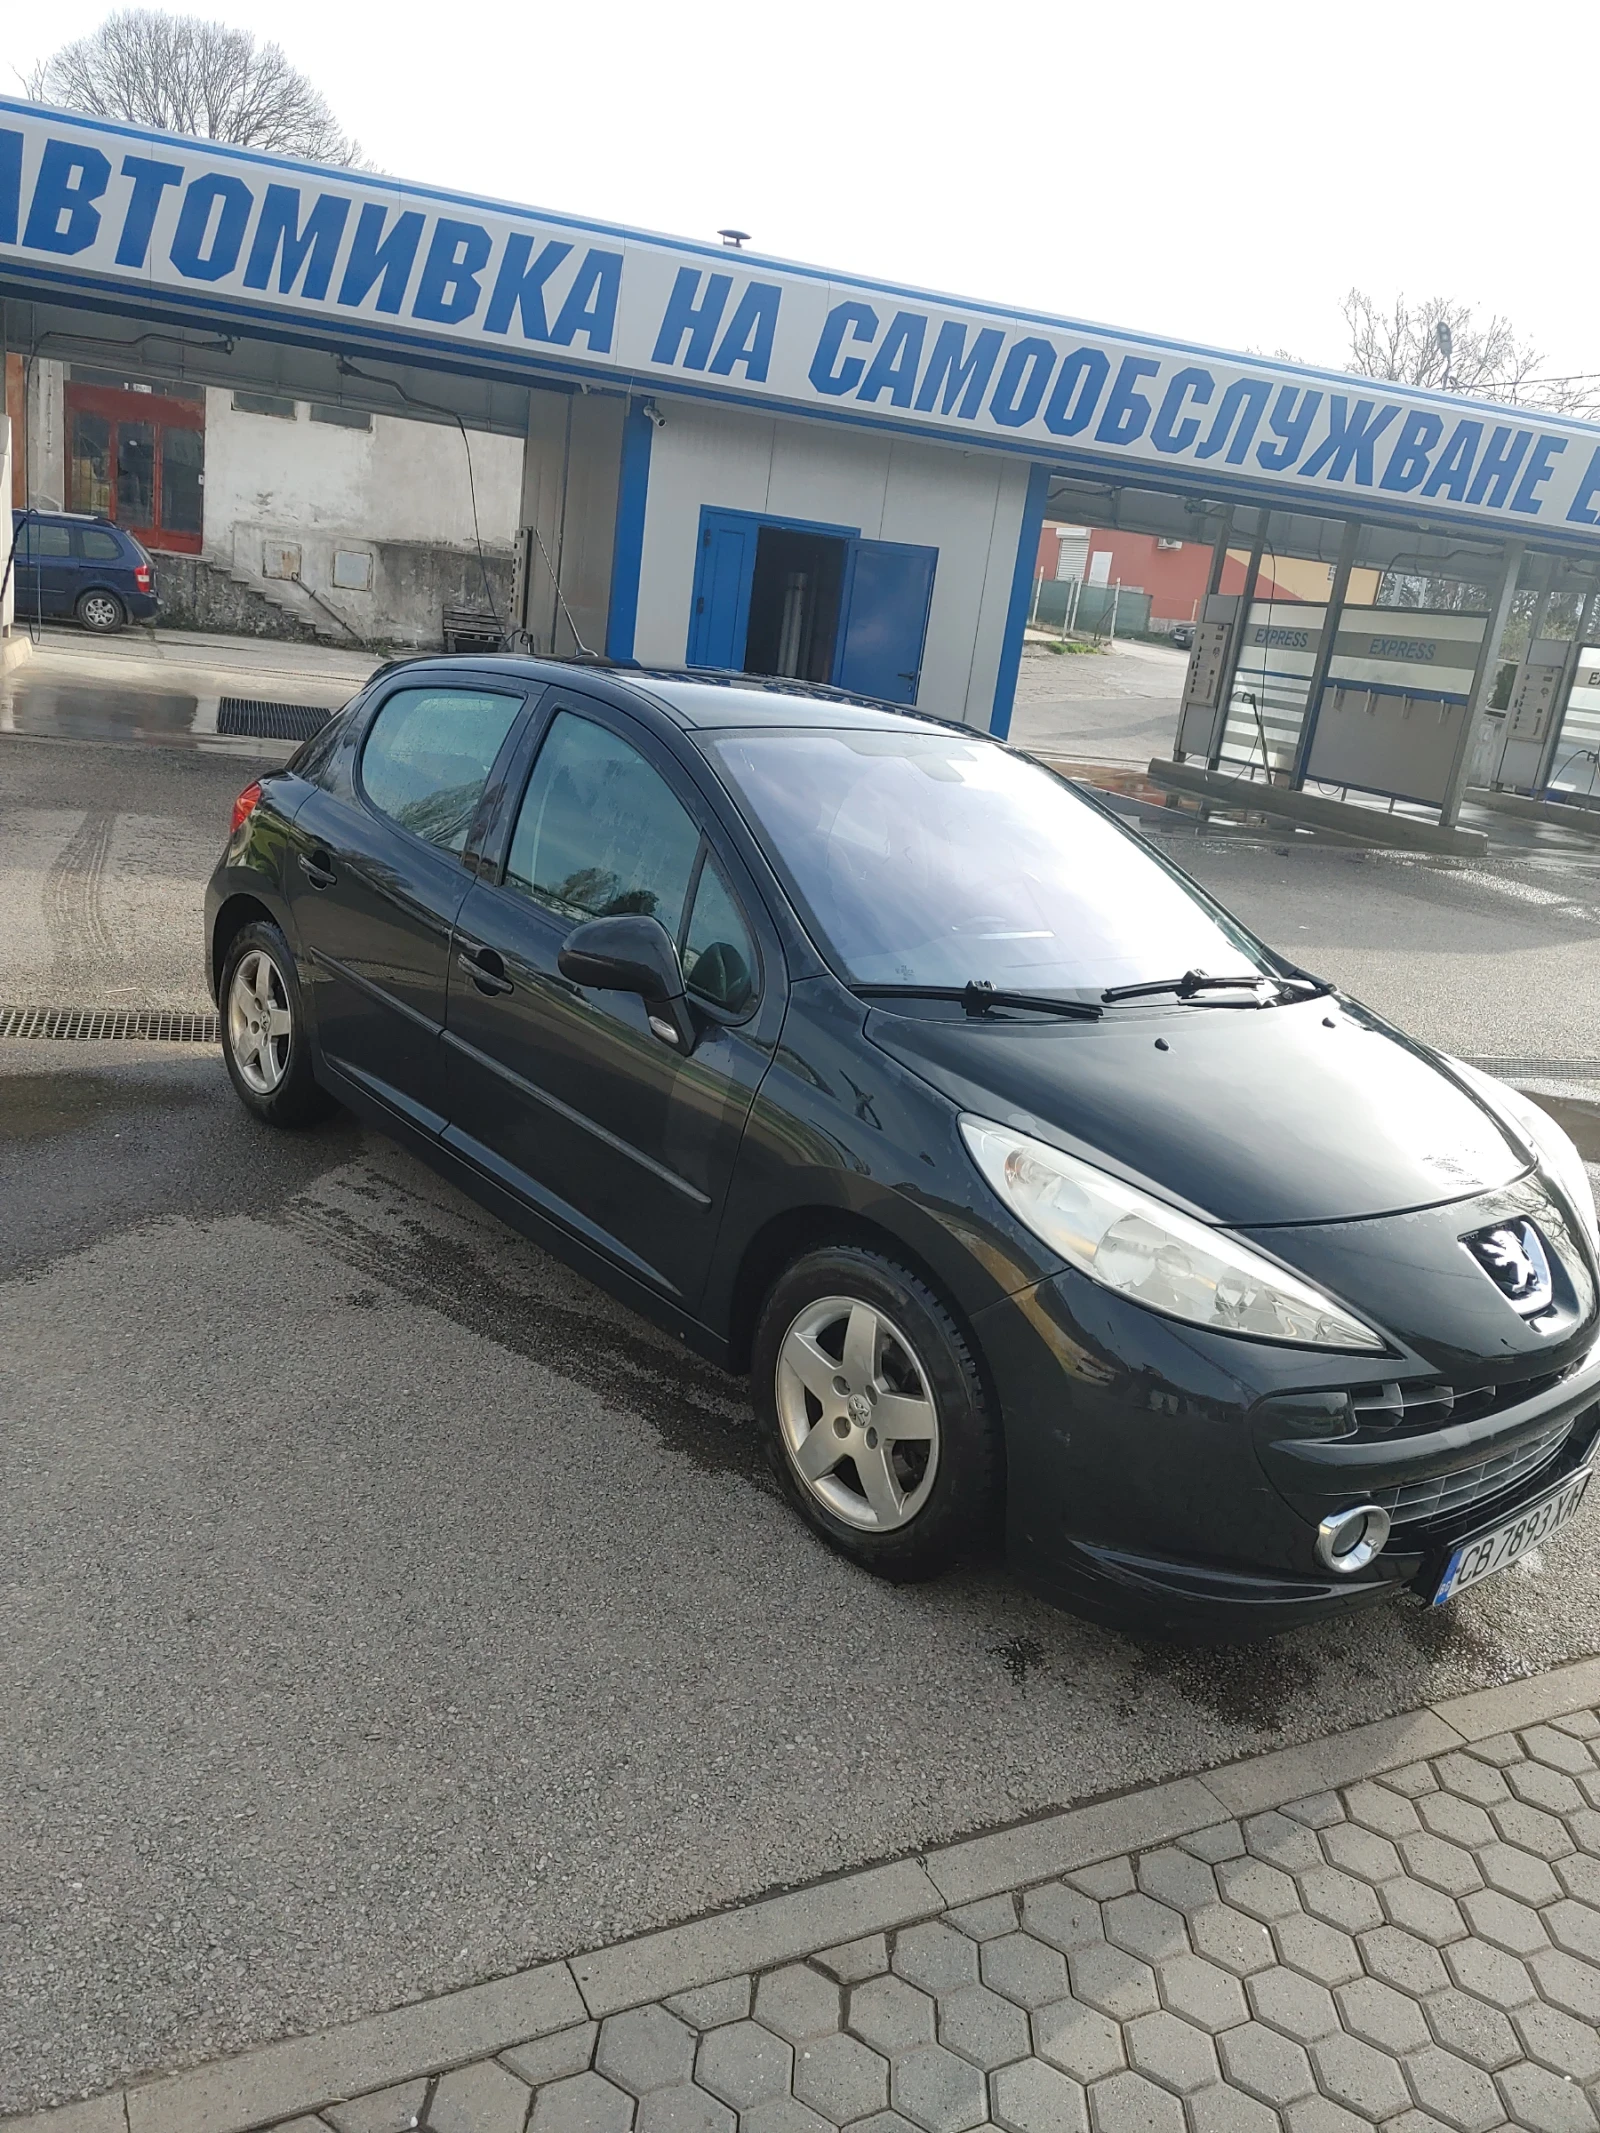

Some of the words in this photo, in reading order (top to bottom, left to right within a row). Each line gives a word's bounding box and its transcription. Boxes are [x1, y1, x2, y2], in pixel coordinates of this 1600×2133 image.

[651, 267, 782, 383] НА
[808, 300, 1569, 515] САМООБСЛУЖВАНЕ
[1254, 628, 1309, 648] EXPRESS
[1368, 638, 1437, 661] EXPRESS
